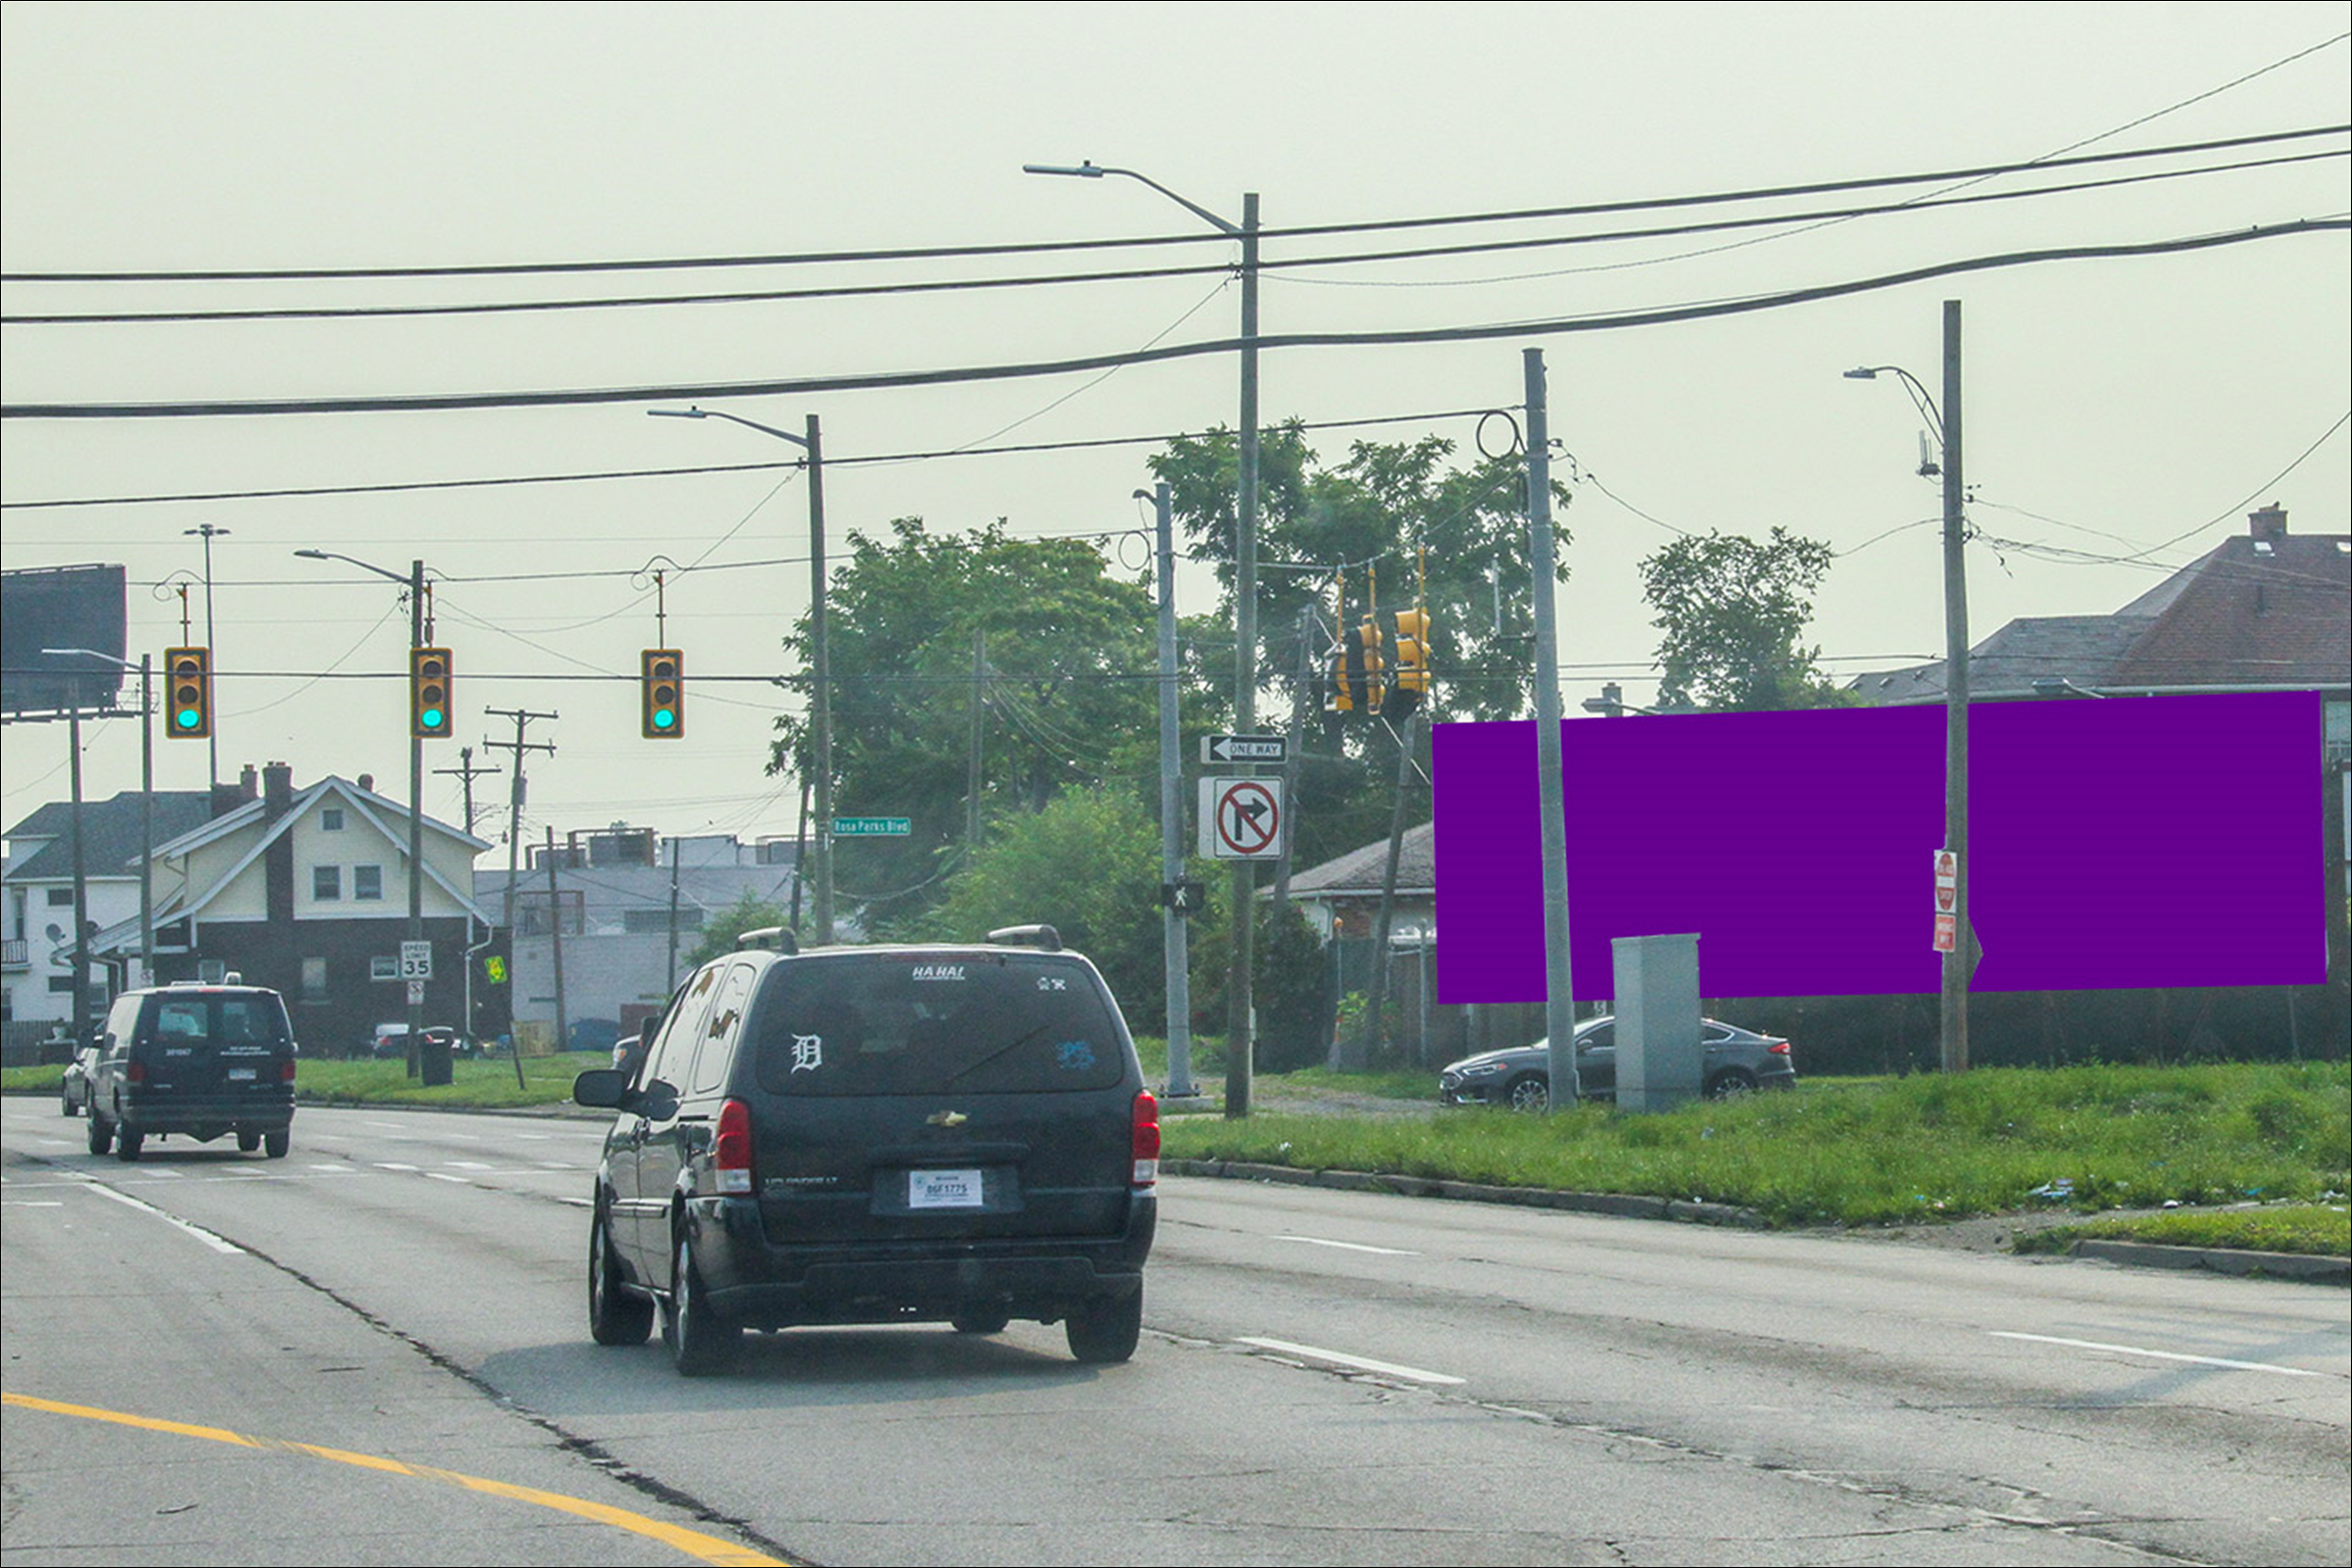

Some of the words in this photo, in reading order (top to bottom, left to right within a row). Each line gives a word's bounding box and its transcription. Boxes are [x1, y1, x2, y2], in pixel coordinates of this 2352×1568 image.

[1230, 745, 1252, 754] ONE
[1256, 745, 1278, 754] WAY
[835, 821, 856, 831] Rosa
[858, 821, 885, 831] Parks
[887, 821, 907, 831] Blvd
[404, 960, 429, 975] 35
